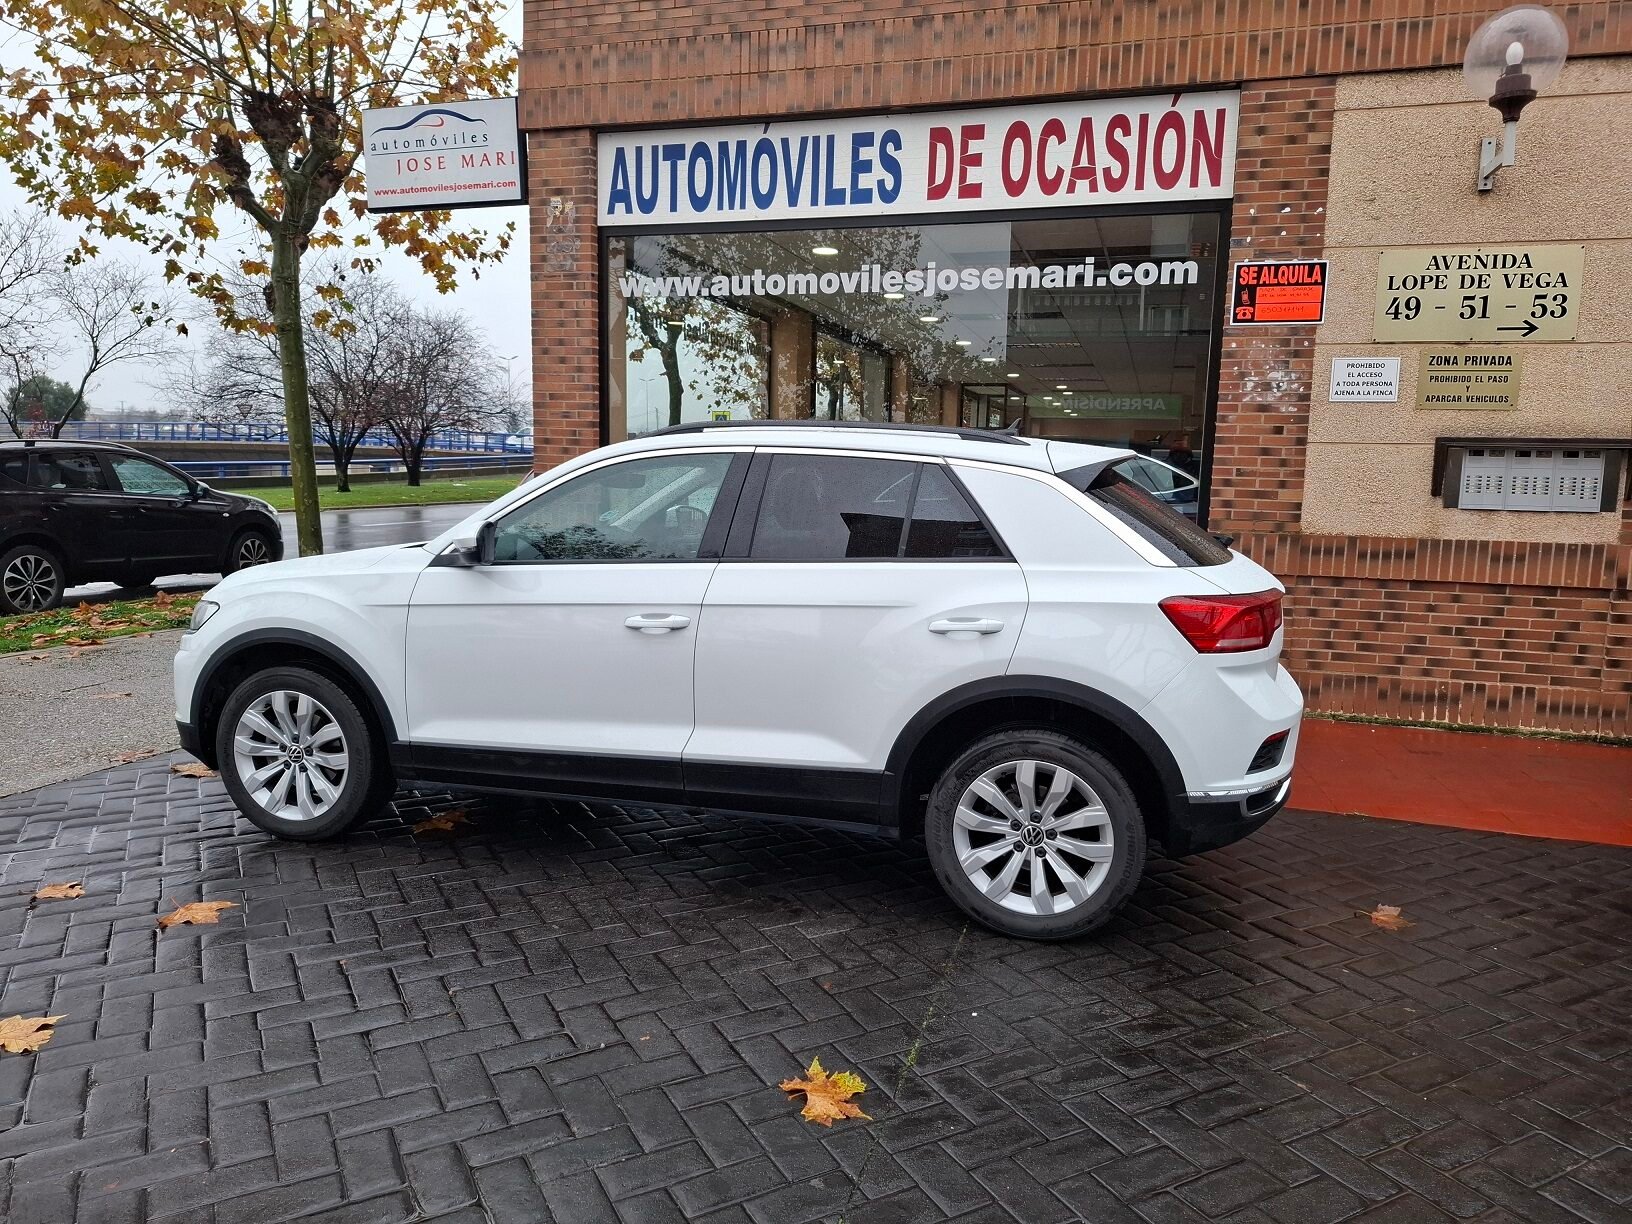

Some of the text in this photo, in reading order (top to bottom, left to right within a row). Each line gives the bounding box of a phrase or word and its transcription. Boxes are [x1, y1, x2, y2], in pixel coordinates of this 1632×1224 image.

[370, 132, 489, 151] automóviles
[396, 150, 516, 176] JOSE MARI
[606, 93, 1227, 215] AUTOMÓVILES DE OCASIÓN
[374, 180, 516, 196] www.automovilesjosemari.com
[1425, 253, 1533, 270] AVENIDA
[618, 256, 1199, 298] www.automovilesjosemari.com
[1239, 264, 1322, 285] SE ALQUILA
[1387, 272, 1569, 291] LOPE DE VEGA
[1385, 295, 1422, 321] 49
[1459, 294, 1491, 320] 51
[1530, 293, 1569, 319] 53
[1428, 355, 1513, 366] ZONA PRIVADA
[1429, 375, 1509, 383] PROHIBIDO EL PASO
[1425, 394, 1509, 403] APARCAR VEHICULOS
[1465, 385, 1471, 393] Y
